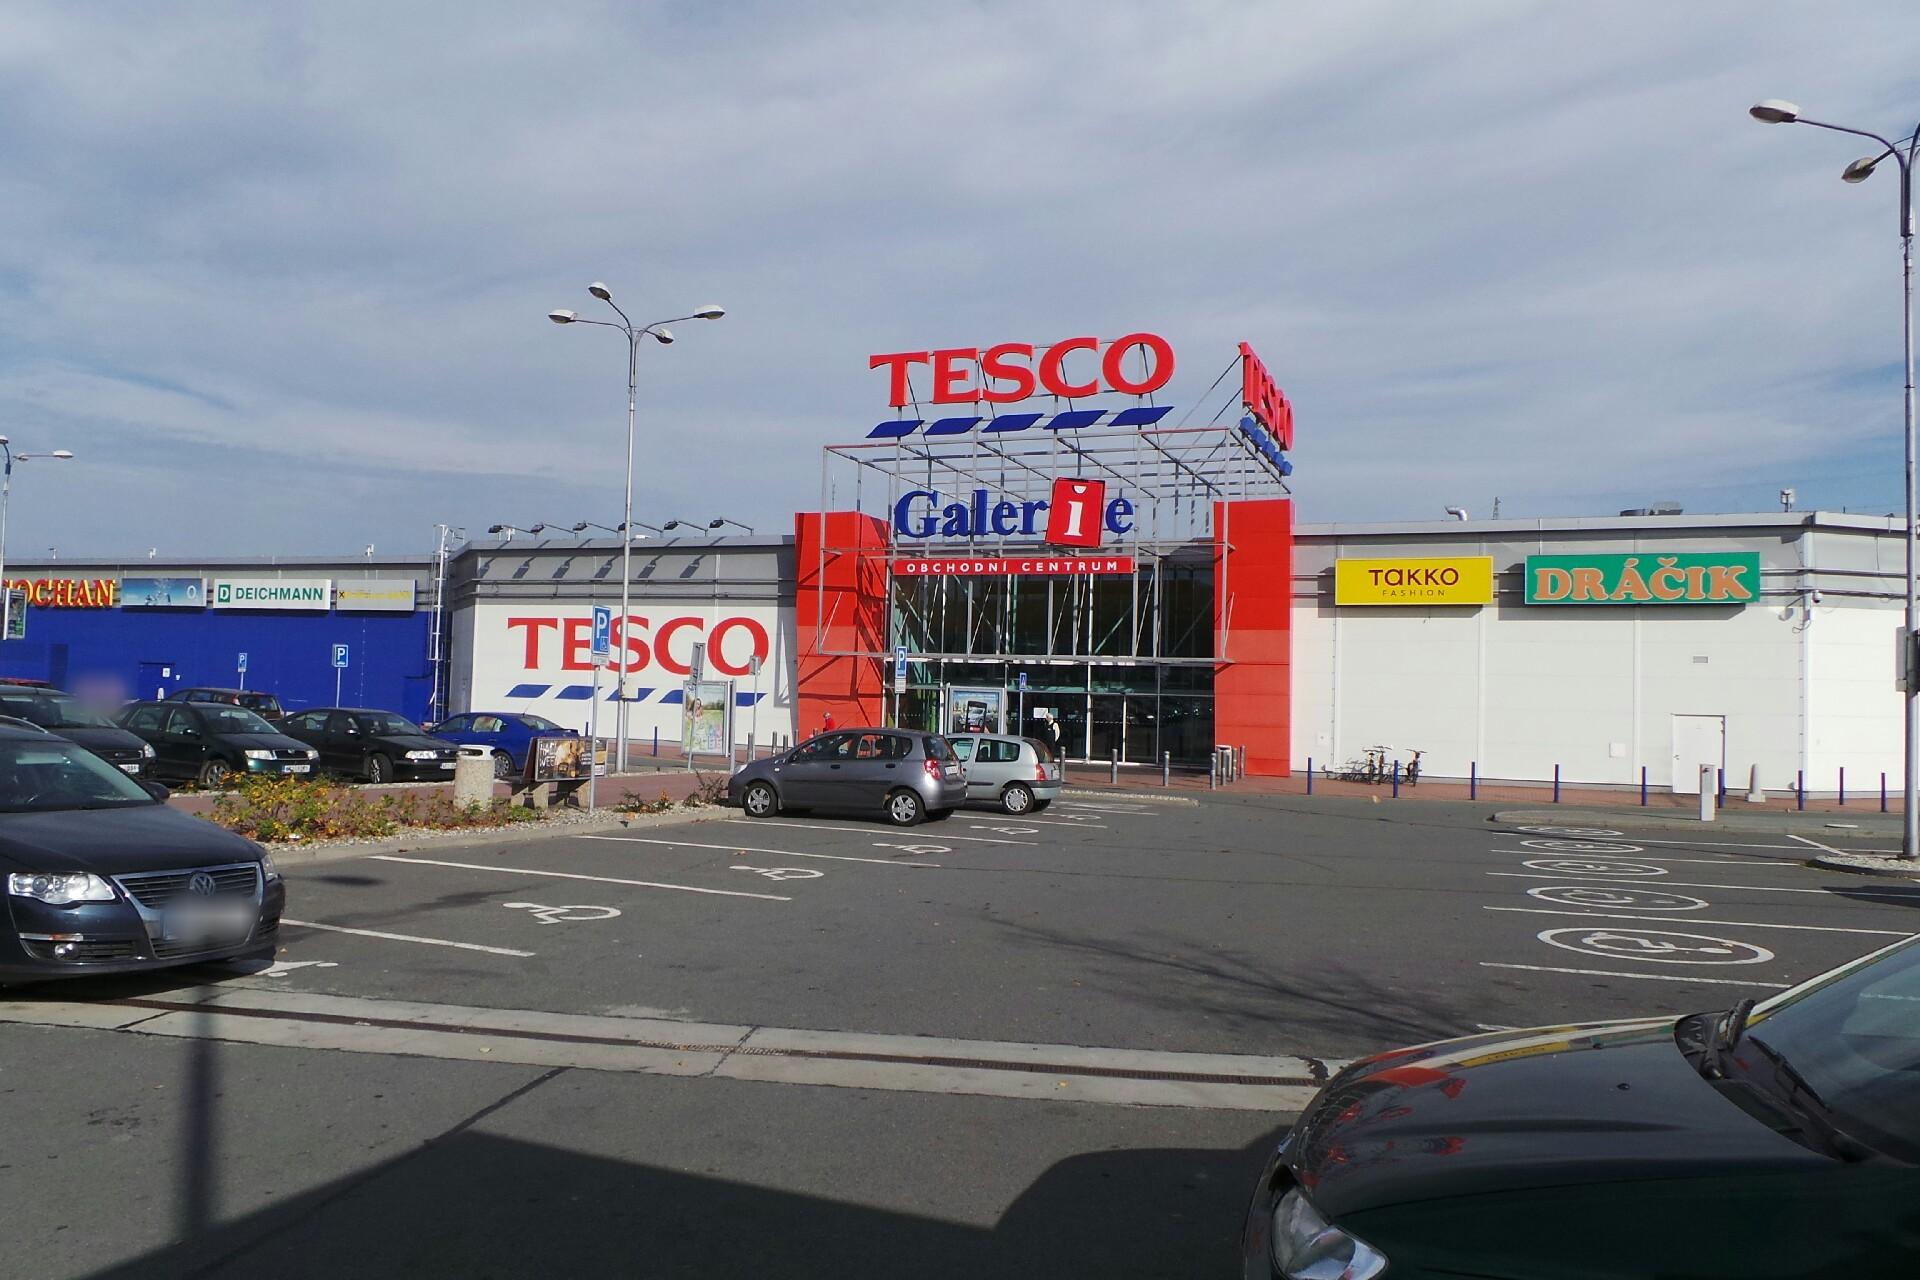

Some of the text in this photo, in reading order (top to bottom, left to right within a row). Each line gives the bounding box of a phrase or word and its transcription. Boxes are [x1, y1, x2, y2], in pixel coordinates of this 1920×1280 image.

[869, 333, 1176, 408] TESCO
[894, 484, 1134, 539] Galerie
[906, 560, 1118, 573] OBCHODNÍ CENTRUM
[1533, 557, 1753, 601] DRÁČIK
[236, 588, 324, 601] DEICHMANN
[1382, 589, 1446, 597] FASHION
[596, 612, 608, 639] P
[337, 647, 346, 660] P
[507, 615, 770, 677] TESCO
